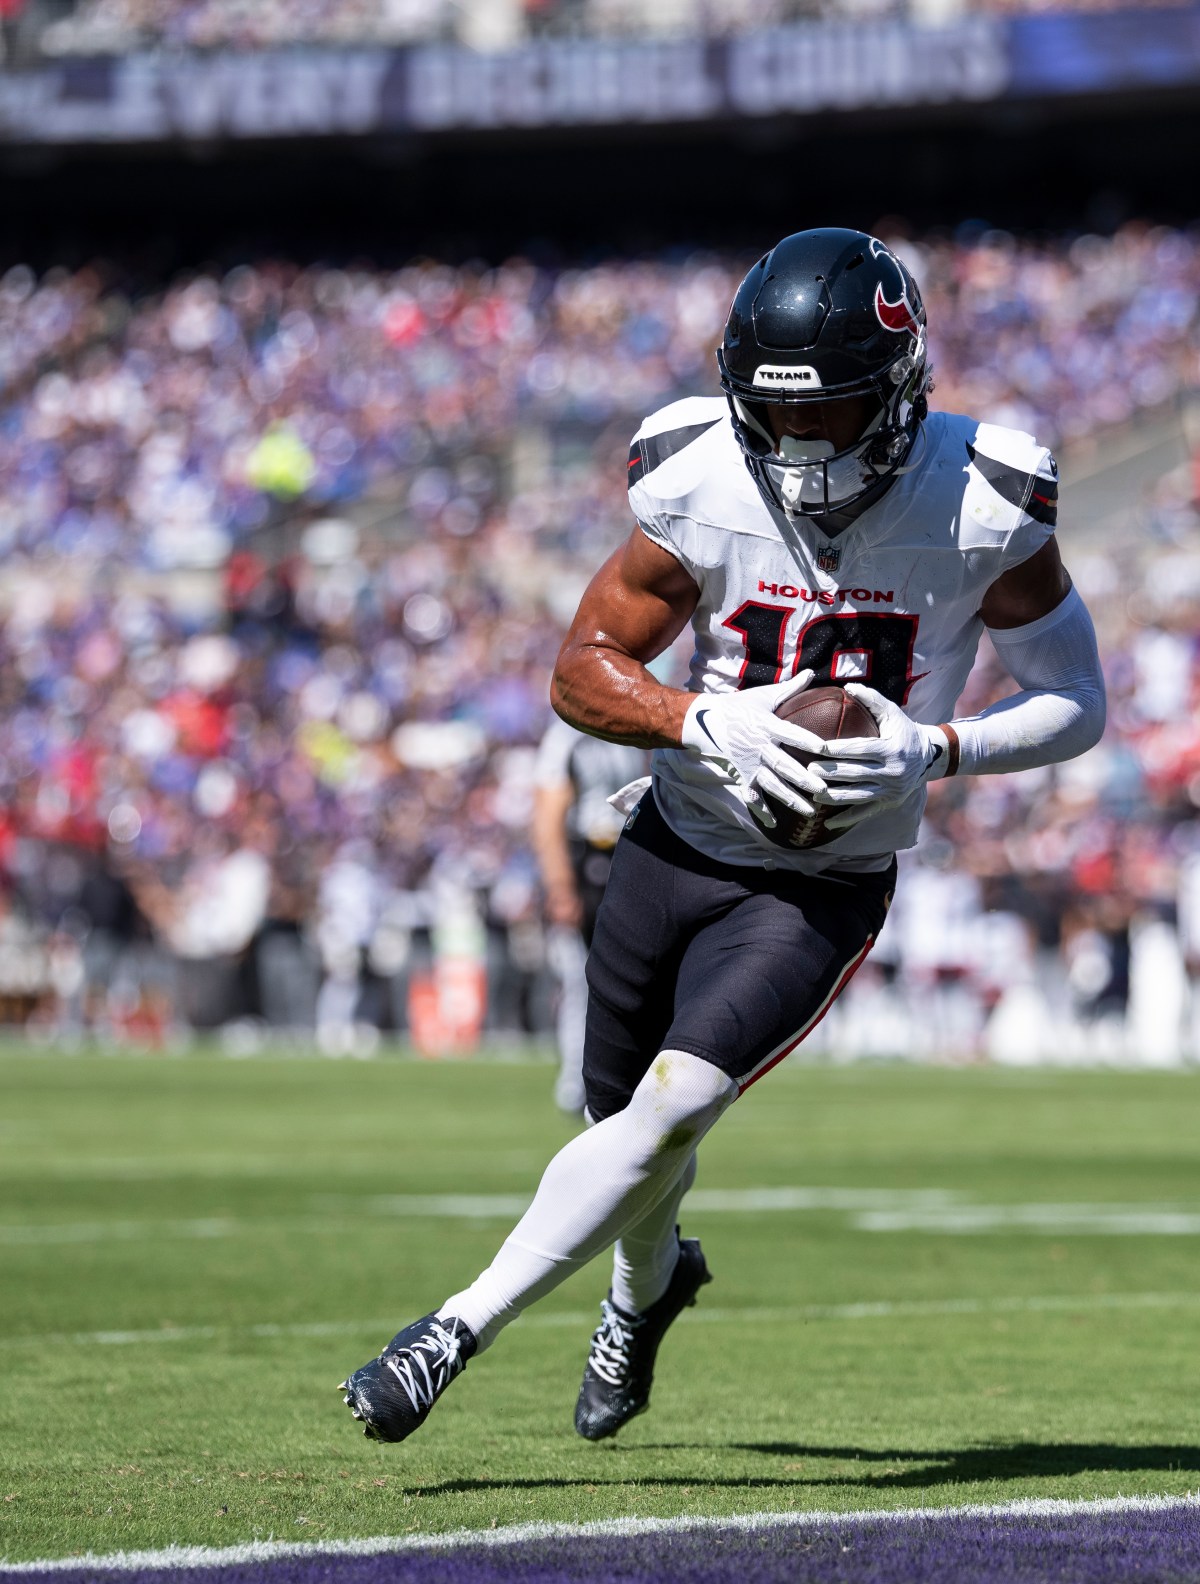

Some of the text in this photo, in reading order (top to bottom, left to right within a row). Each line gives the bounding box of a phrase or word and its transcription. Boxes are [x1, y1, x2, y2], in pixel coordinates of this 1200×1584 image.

[759, 371, 811, 381] TEXANS
[819, 556, 838, 570] NFL
[758, 580, 894, 605] HOUSTON
